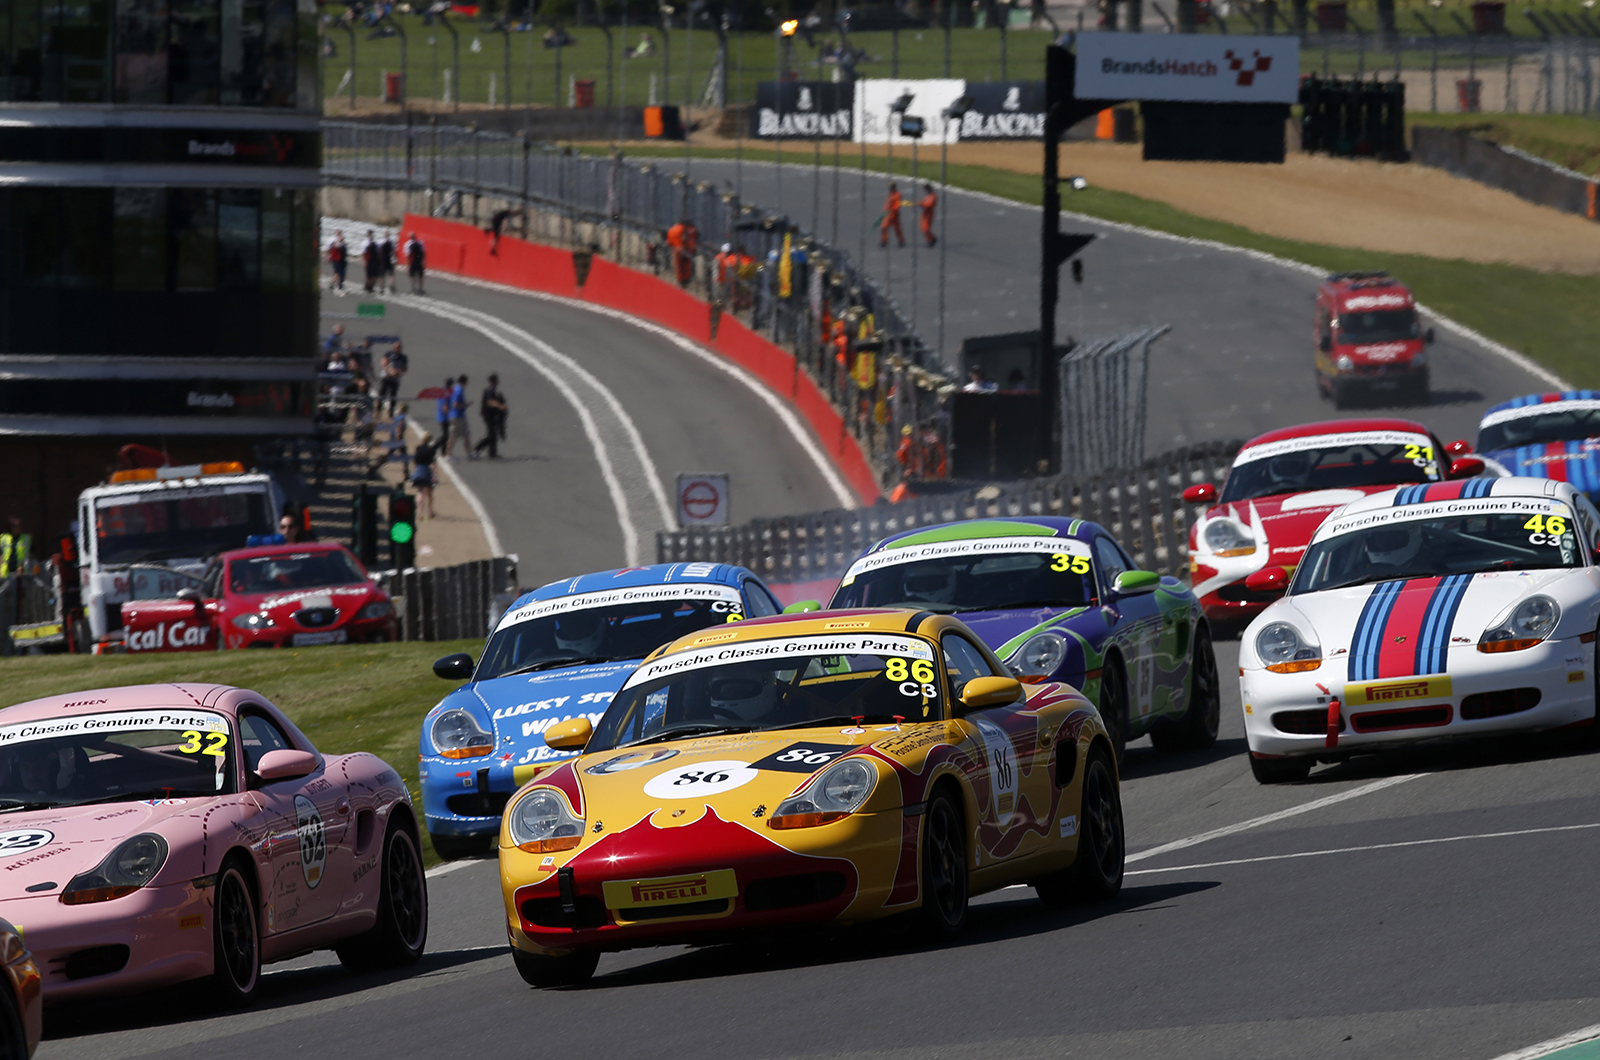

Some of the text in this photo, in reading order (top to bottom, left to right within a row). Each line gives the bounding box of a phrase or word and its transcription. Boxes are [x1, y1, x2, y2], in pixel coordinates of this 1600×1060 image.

[1101, 57, 1218, 77] BrandsHatch
[758, 107, 851, 137] BLANCPAIN
[1404, 443, 1434, 460] 21
[1332, 501, 1551, 533] Porsche Classic Genuine Parts
[1523, 514, 1567, 535] 46
[1528, 532, 1561, 547] C3
[865, 540, 1072, 568] Porsche Classic Genuine Parts
[1050, 553, 1091, 575] 35
[514, 587, 722, 621] Porsche Classic Genuine Parts
[711, 601, 743, 614] C3
[168, 620, 210, 648] Car
[648, 655, 714, 676] Porsche
[718, 645, 780, 661] Classic
[783, 640, 857, 653] Genuine
[861, 640, 909, 652] Parts
[885, 657, 935, 684] 86
[899, 682, 938, 699] C3
[1366, 681, 1429, 701] PIRELLI
[493, 695, 571, 719] LUCKY
[20, 721, 79, 738] Classic
[83, 716, 155, 730] Genuine
[158, 715, 206, 727] Parts
[178, 730, 229, 757] 32
[776, 749, 843, 765] 86
[994, 746, 1012, 790] 86
[672, 768, 735, 787] 86
[631, 878, 708, 903] PIRELLI
